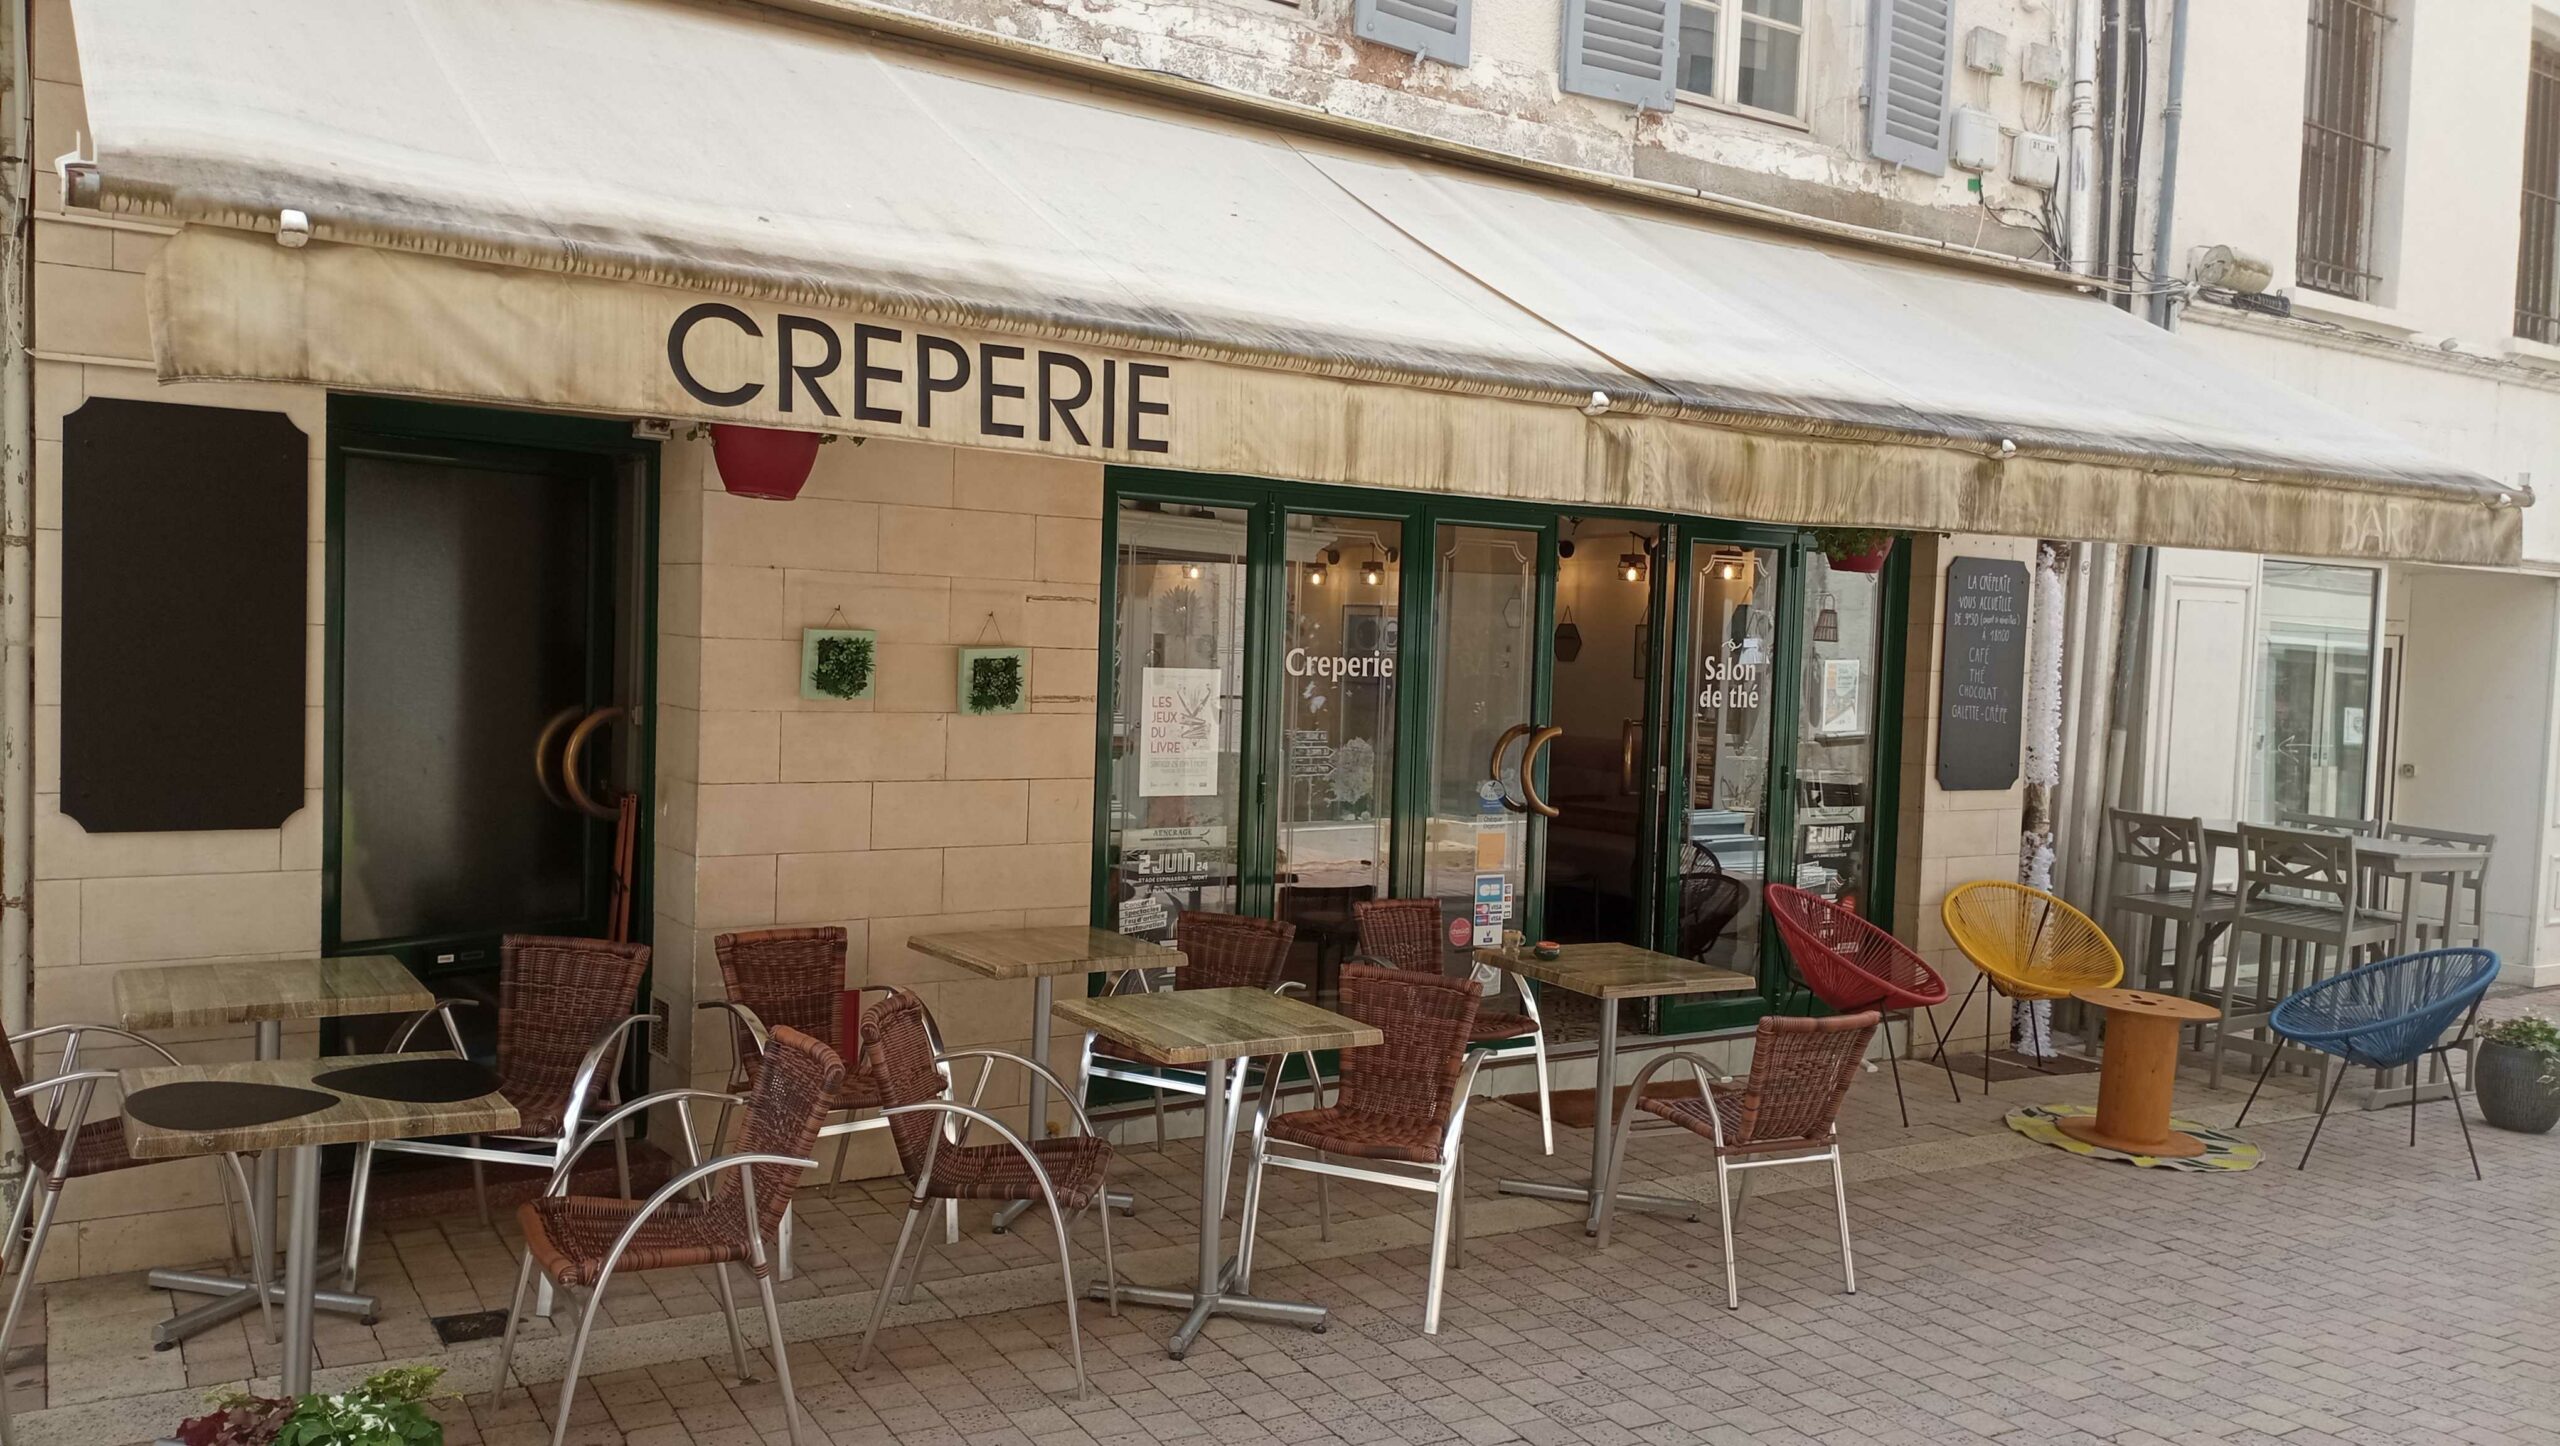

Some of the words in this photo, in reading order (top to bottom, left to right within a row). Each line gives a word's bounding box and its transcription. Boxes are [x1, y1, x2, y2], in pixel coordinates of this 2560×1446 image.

[667, 302, 1170, 454] CREPERIE
[1967, 575, 1977, 590] LA
[1285, 647, 1393, 682] Creperie
[1968, 645, 1991, 665] CAFÉ
[1704, 655, 1756, 681] Salon
[1970, 665, 1986, 684] THÉ
[1699, 684, 1722, 708] de
[1729, 684, 1759, 708] thé
[1958, 684, 1998, 700] CHOCOLAT
[1151, 696, 1172, 708] LES
[1151, 711, 1178, 723] JEUX
[1151, 726, 1166, 738] DU
[1150, 741, 1181, 754] LIVRE
[1138, 855, 1150, 874] 2
[1196, 861, 1208, 871] 24
